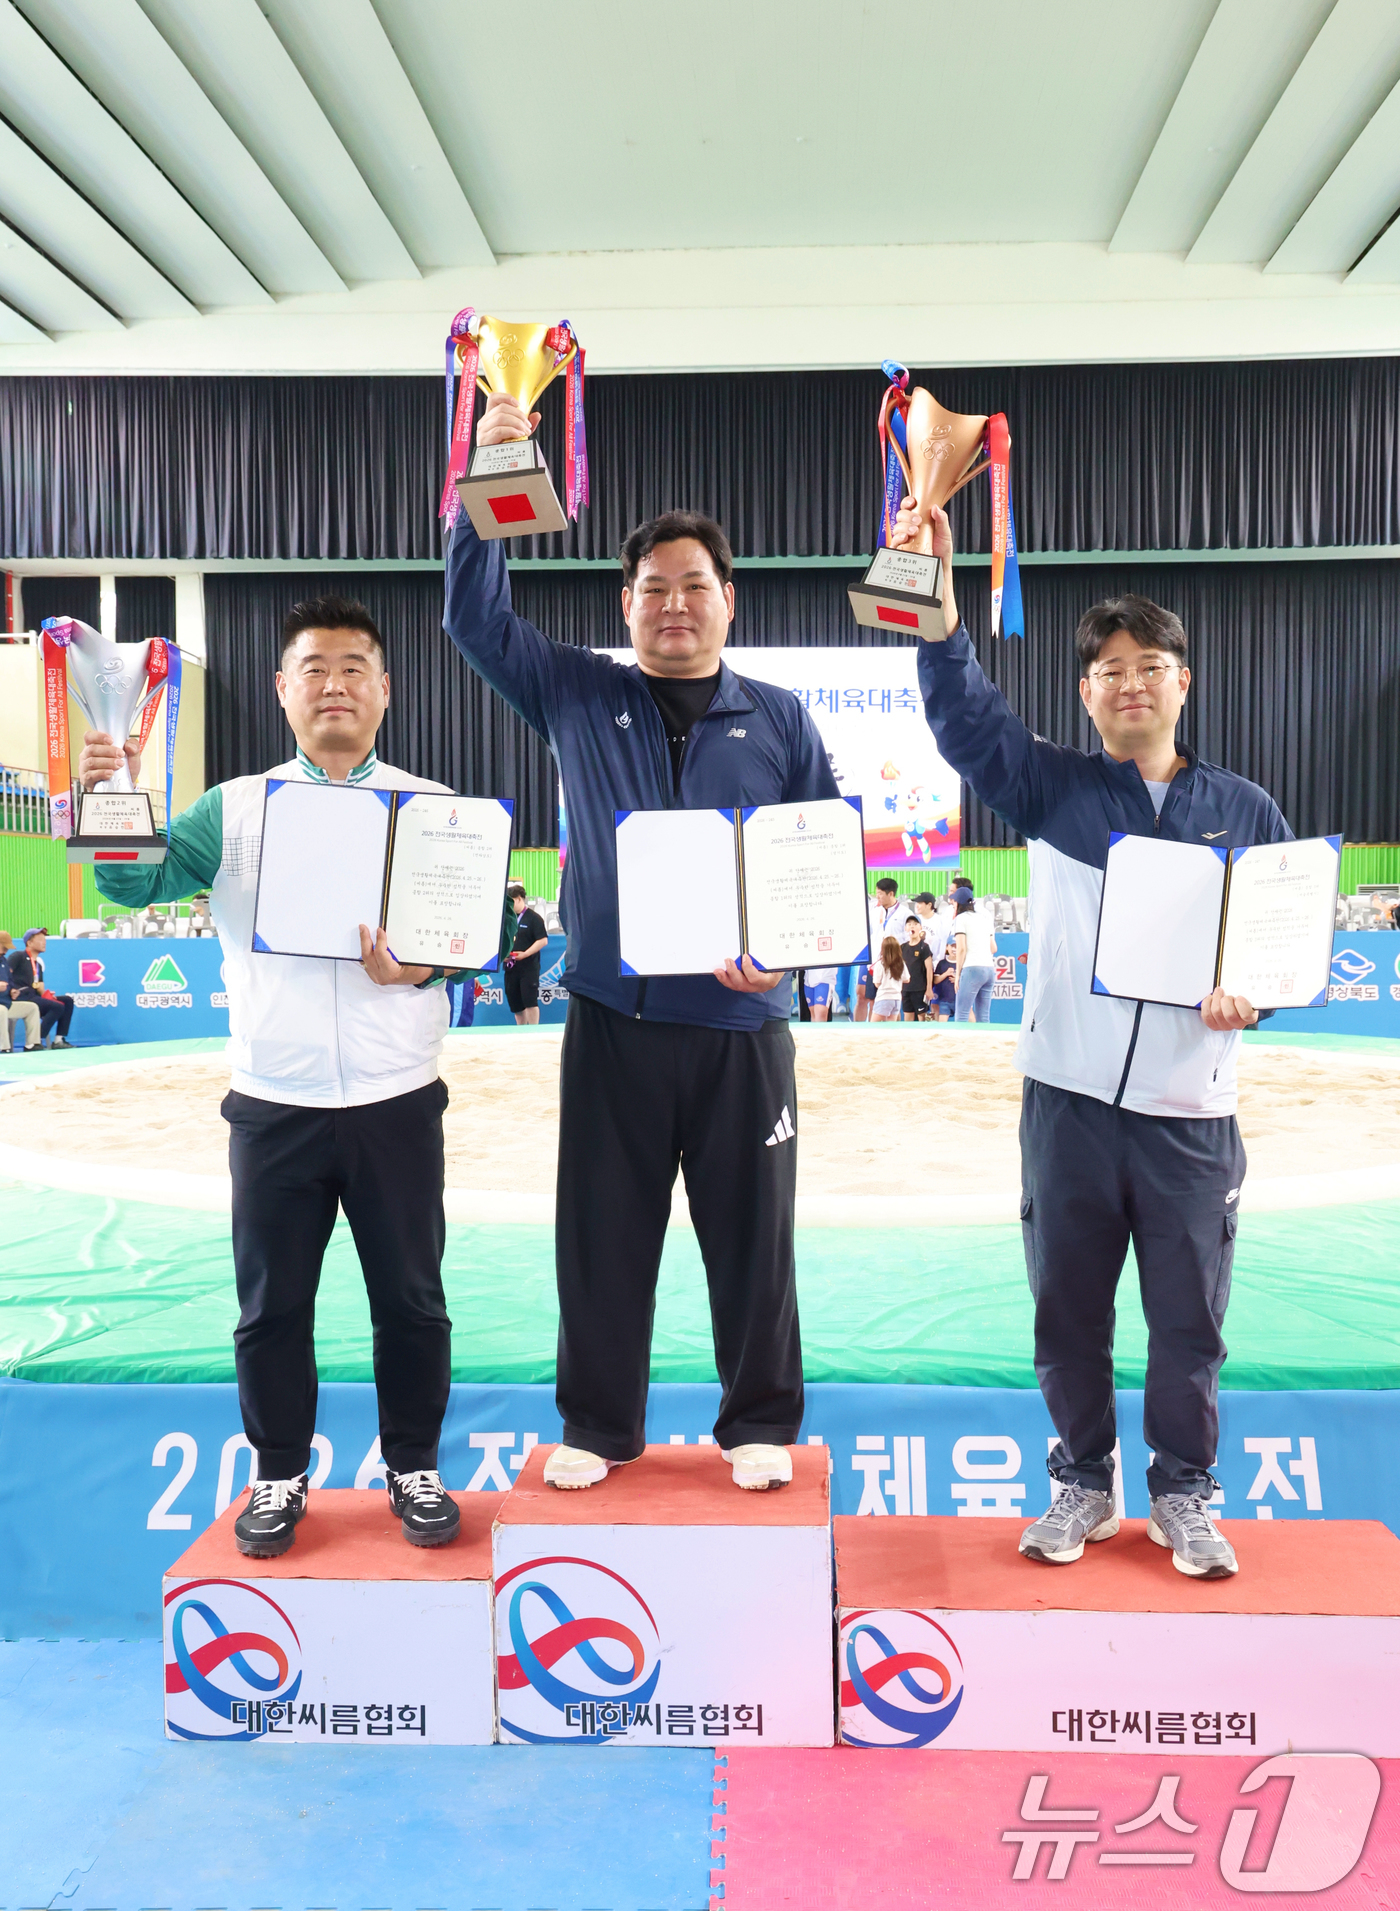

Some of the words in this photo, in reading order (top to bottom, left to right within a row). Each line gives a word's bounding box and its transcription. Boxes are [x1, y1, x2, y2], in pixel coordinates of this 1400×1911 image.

[470, 355, 478, 372] 2026
[47, 668, 58, 738] 전국생활체육대축전
[790, 688, 924, 713] 활체육대축
[50, 739, 59, 758] 2026
[435, 831, 483, 840] 전국생활체육대축전
[785, 833, 834, 843] 전국생활체육대축전
[72, 994, 116, 1006] 산광역시
[138, 995, 190, 1006] 대구광역시
[230, 1700, 426, 1737] 대한씨름협회
[564, 1701, 763, 1737] 대한씨름협회
[1051, 1708, 1257, 1746] 대한씨름협회
